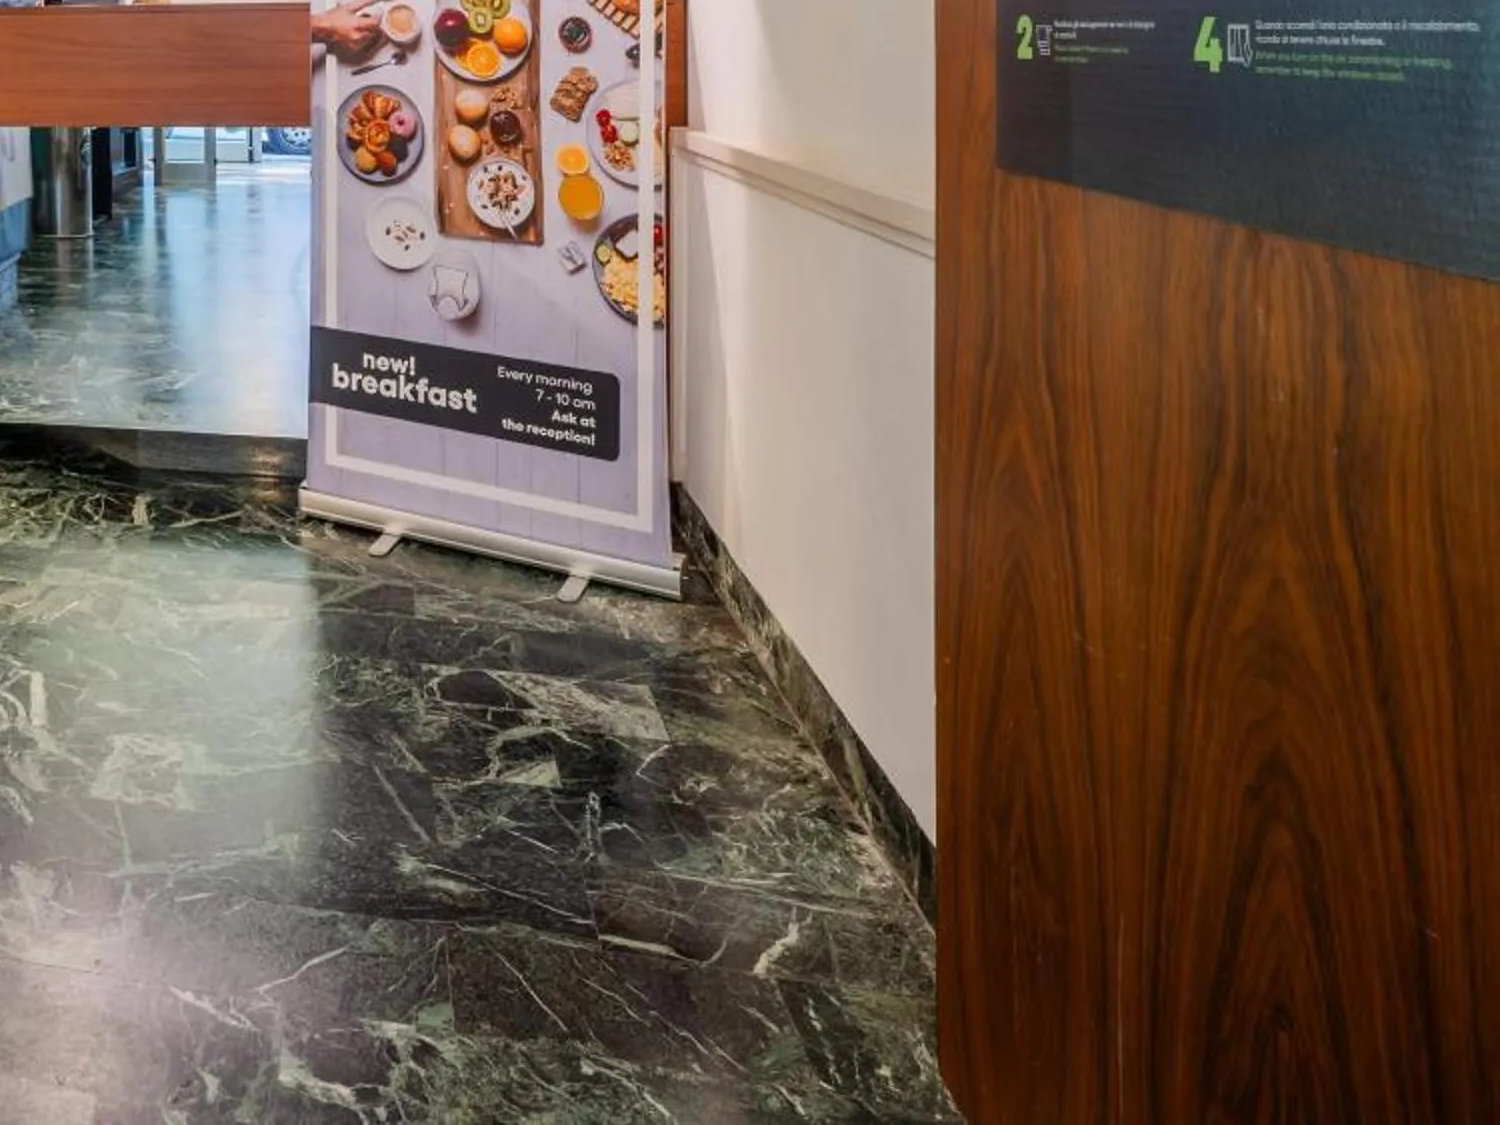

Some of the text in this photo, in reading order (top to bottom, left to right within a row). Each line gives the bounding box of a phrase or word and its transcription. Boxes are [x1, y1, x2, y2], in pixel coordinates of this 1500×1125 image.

[1016, 14, 1034, 60] 2
[1193, 17, 1223, 73] 4
[363, 352, 415, 376] new!
[331, 363, 478, 414] breakfast
[497, 366, 593, 396] Every morning
[534, 389, 543, 403] 7
[556, 390, 570, 406] 10
[572, 395, 596, 411] am
[501, 418, 595, 447] the reception!
[551, 409, 597, 429] Ask at
